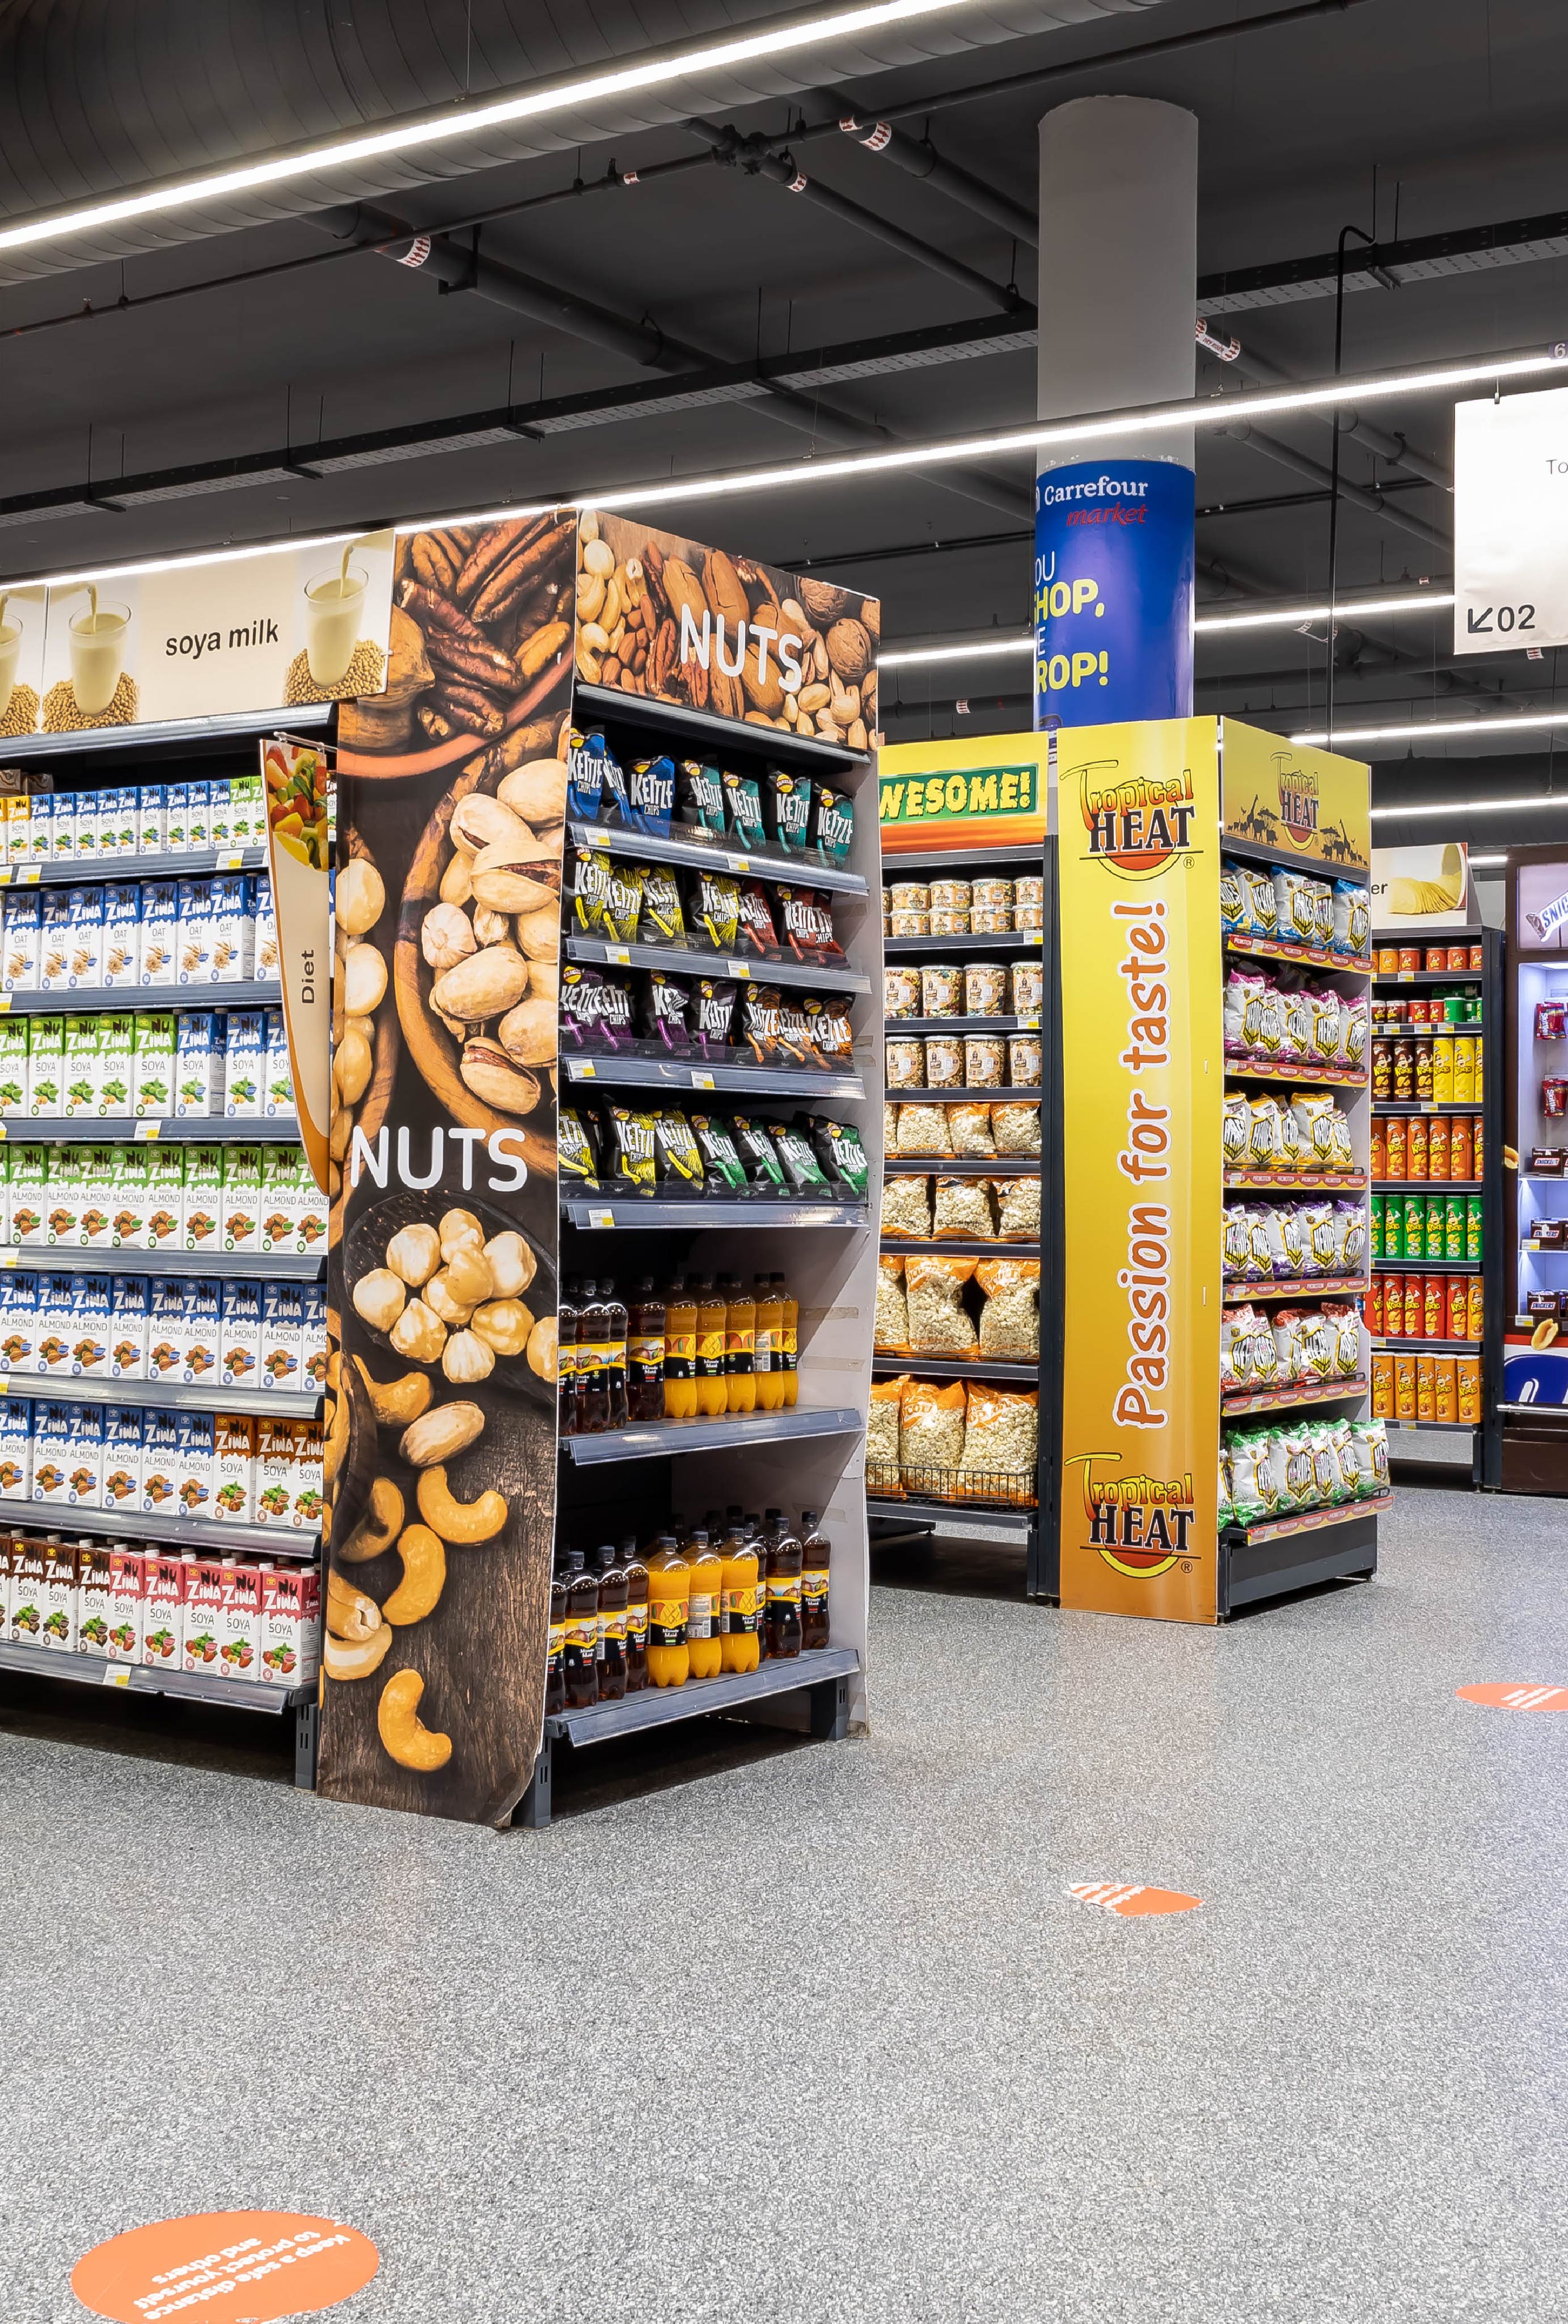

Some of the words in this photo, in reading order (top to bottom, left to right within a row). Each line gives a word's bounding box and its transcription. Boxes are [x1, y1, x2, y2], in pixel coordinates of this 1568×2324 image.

[1044, 476, 1148, 506] Carrefour
[1066, 502, 1148, 526] market
[1035, 551, 1055, 587] OU
[1034, 579, 1105, 624] HOP,
[1497, 605, 1536, 632] 02
[166, 631, 221, 659] soya
[229, 618, 279, 648] milk
[1037, 626, 1046, 656] E
[681, 603, 803, 692] NUTS
[1036, 651, 1109, 695] ROP!
[1270, 752, 1319, 805] Tropical
[631, 774, 673, 809] KETTLE
[880, 771, 1030, 819] WESOME!
[1059, 760, 1194, 830] Tropical
[644, 804, 660, 816] CHIPS
[1281, 791, 1320, 830] HEAT
[786, 822, 800, 834] CHIPS
[1089, 806, 1195, 853] HEAT
[815, 932, 833, 944] CHIPS
[302, 949, 315, 1003] Diet
[1114, 902, 1167, 1070] taste!
[610, 1014, 626, 1025] CHIPS
[36, 1062, 56, 1072] SOYA
[142, 1061, 166, 1070] SOYA
[183, 1061, 204, 1070] SOYA
[233, 1060, 253, 1069] SOYA
[1121, 1093, 1167, 1181] for
[350, 1125, 528, 1191] NUTS
[12, 1192, 42, 1201] ALMOND
[186, 1195, 218, 1204] ALMOND
[225, 1195, 257, 1204] ALMOND
[264, 1196, 296, 1205] ALMOND
[298, 1197, 329, 1206] ALMOND
[1115, 1206, 1168, 1424] Passion
[39, 1320, 71, 1329] ALMOND
[184, 1328, 217, 1338] ALMOND
[223, 1329, 257, 1339] ALMOND
[265, 1331, 300, 1342] ALMOND
[35, 1447, 66, 1457] ALMOND
[106, 1454, 138, 1464] ALMOND
[220, 1463, 243, 1473] SOYA
[263, 1465, 287, 1477] SOYA
[299, 1469, 321, 1481] SOYA
[1064, 1452, 1194, 1521] Tropical
[1089, 1503, 1195, 1552] HEAT
[159, 1566, 177, 1583] NU
[200, 1570, 220, 1584] NU
[236, 1574, 256, 1591] NU
[278, 1578, 298, 1596] NU
[84, 1597, 104, 1609] SOYA
[150, 1608, 172, 1620] SOYA
[191, 1612, 214, 1625] SOYA
[226, 1618, 250, 1630] SOYA
[268, 1623, 292, 1635] SOYA
[293, 2231, 321, 2242] to
[219, 2238, 262, 2258] and
[295, 2234, 350, 2258] Keep
[219, 2238, 296, 2273] protect
[280, 2255, 297, 2263] a
[151, 2254, 221, 2284] others
[235, 2261, 282, 2282] safe
[133, 2269, 223, 2309] yourself
[143, 2280, 236, 2319] distance
